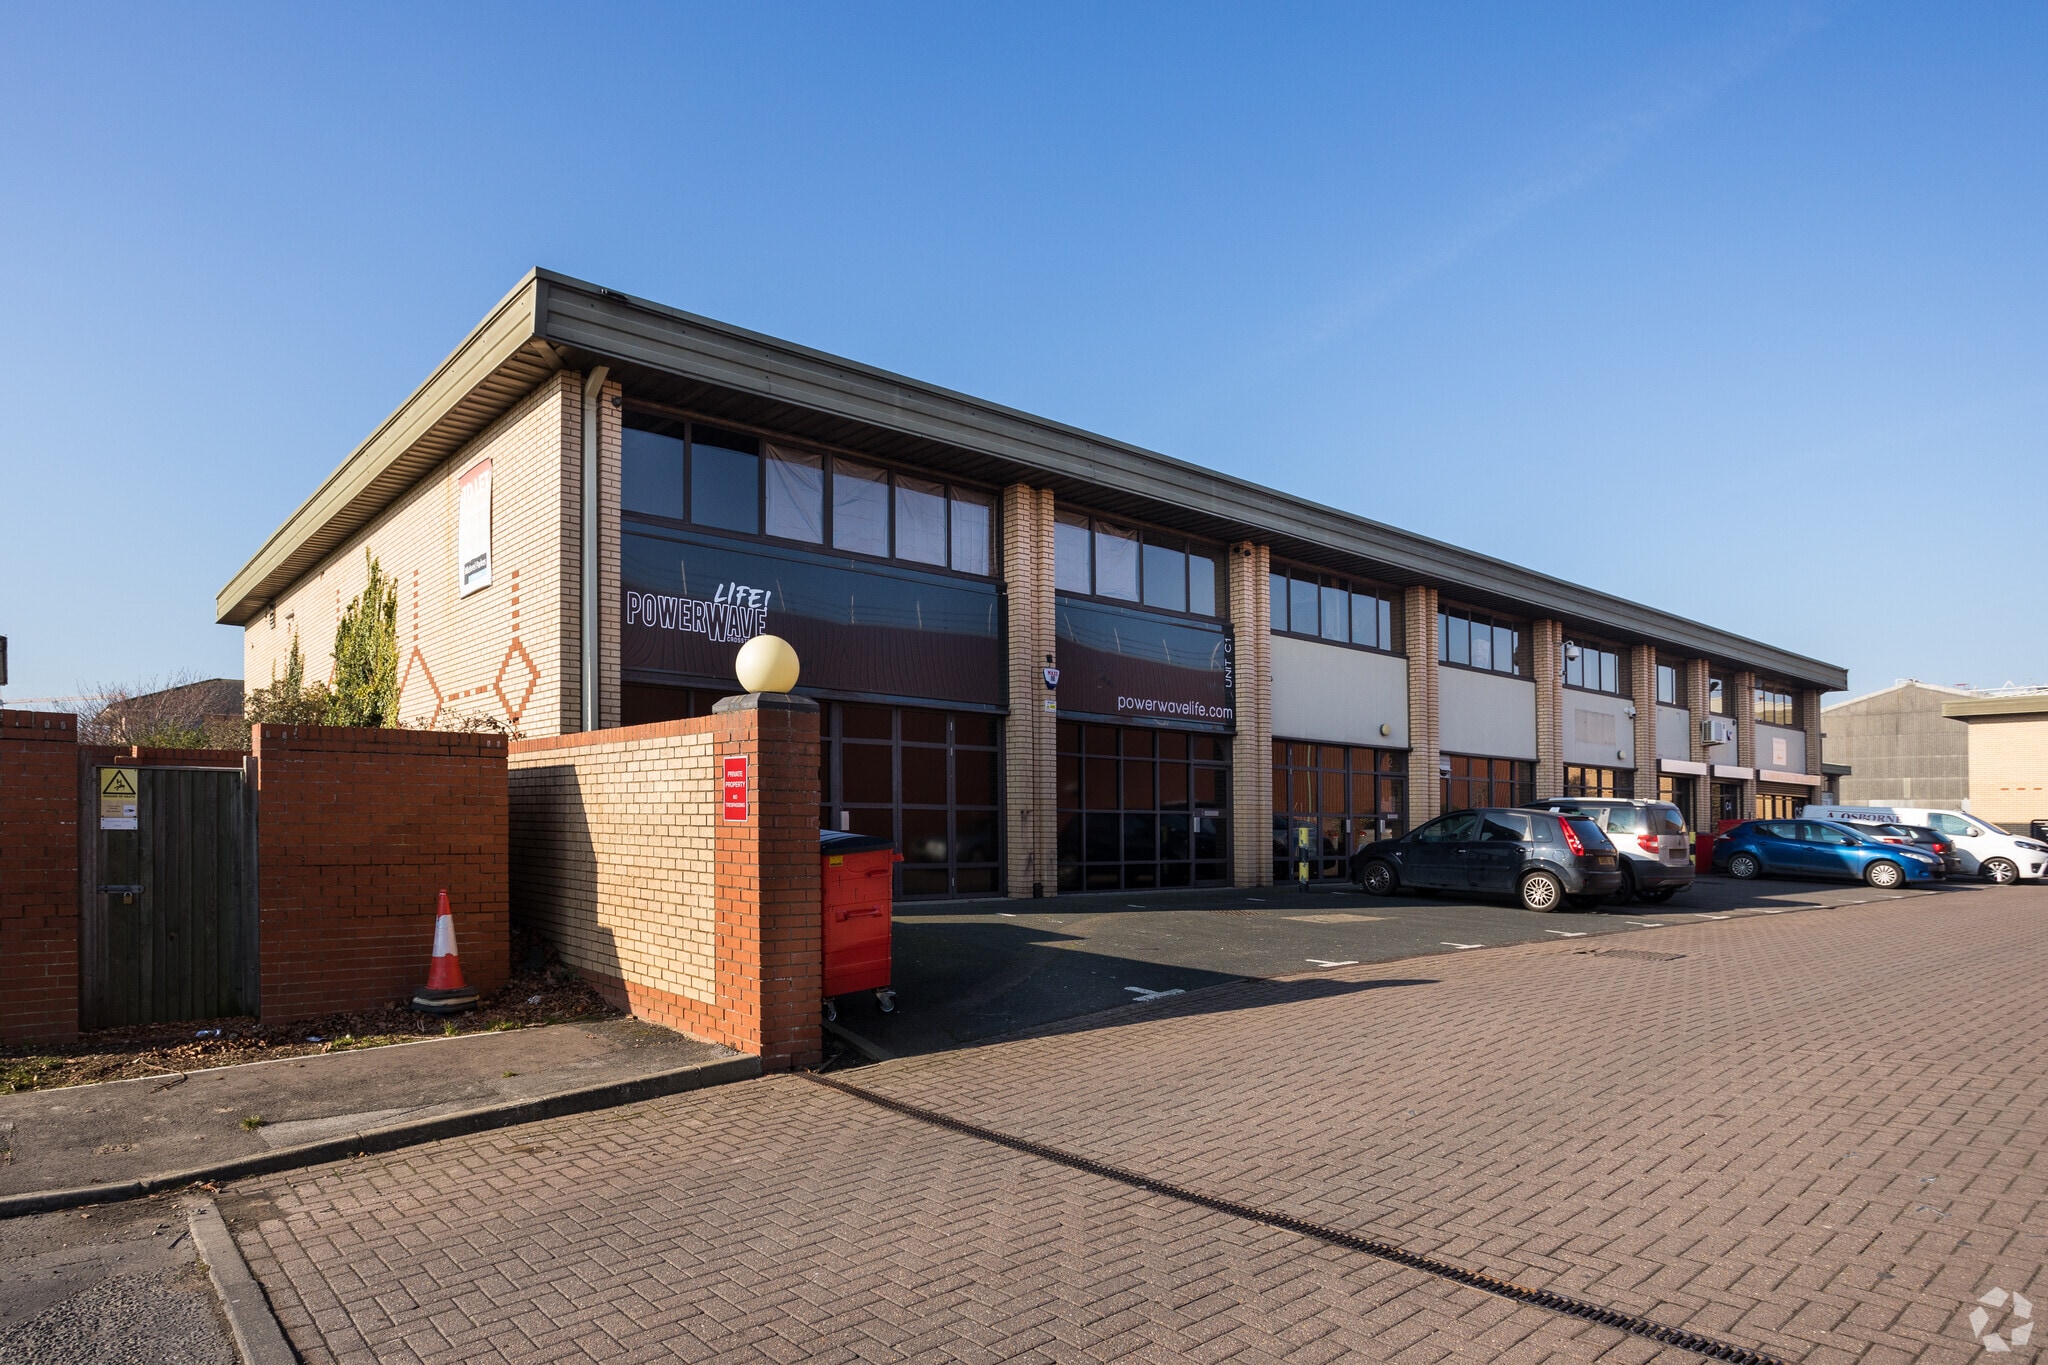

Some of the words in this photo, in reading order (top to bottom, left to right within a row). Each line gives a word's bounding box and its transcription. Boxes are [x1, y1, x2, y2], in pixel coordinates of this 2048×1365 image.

[714, 582, 771, 610] LIFE!
[1224, 638, 1232, 653] C1
[1224, 659, 1233, 688] UNIT
[1118, 695, 1233, 719] powerwavelife.com
[1827, 811, 1834, 819] A
[1841, 811, 1903, 824] OSBORNE
